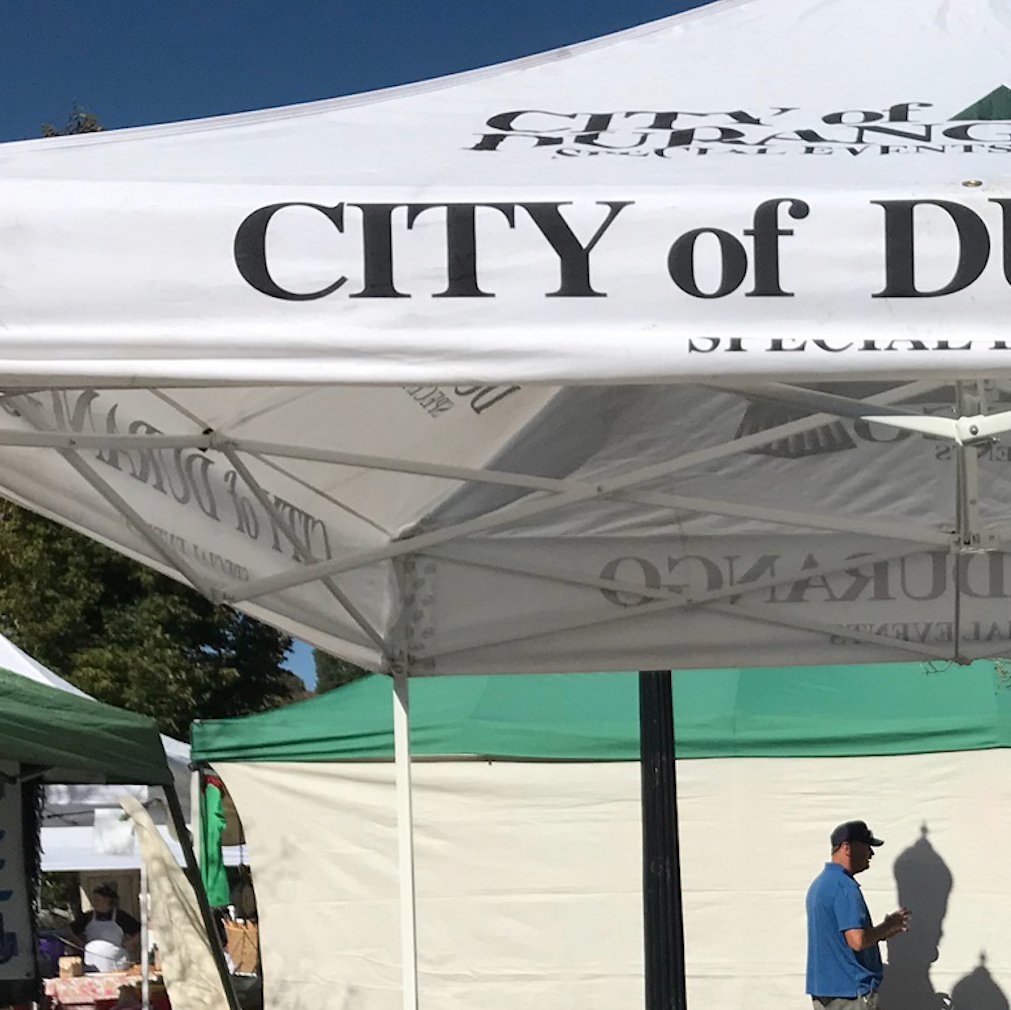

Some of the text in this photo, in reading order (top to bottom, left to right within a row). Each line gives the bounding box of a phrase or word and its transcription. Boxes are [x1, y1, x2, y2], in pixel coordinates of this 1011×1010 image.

[486, 102, 933, 133] CITY of
[233, 200, 635, 301] CITY
[667, 197, 810, 299] of
